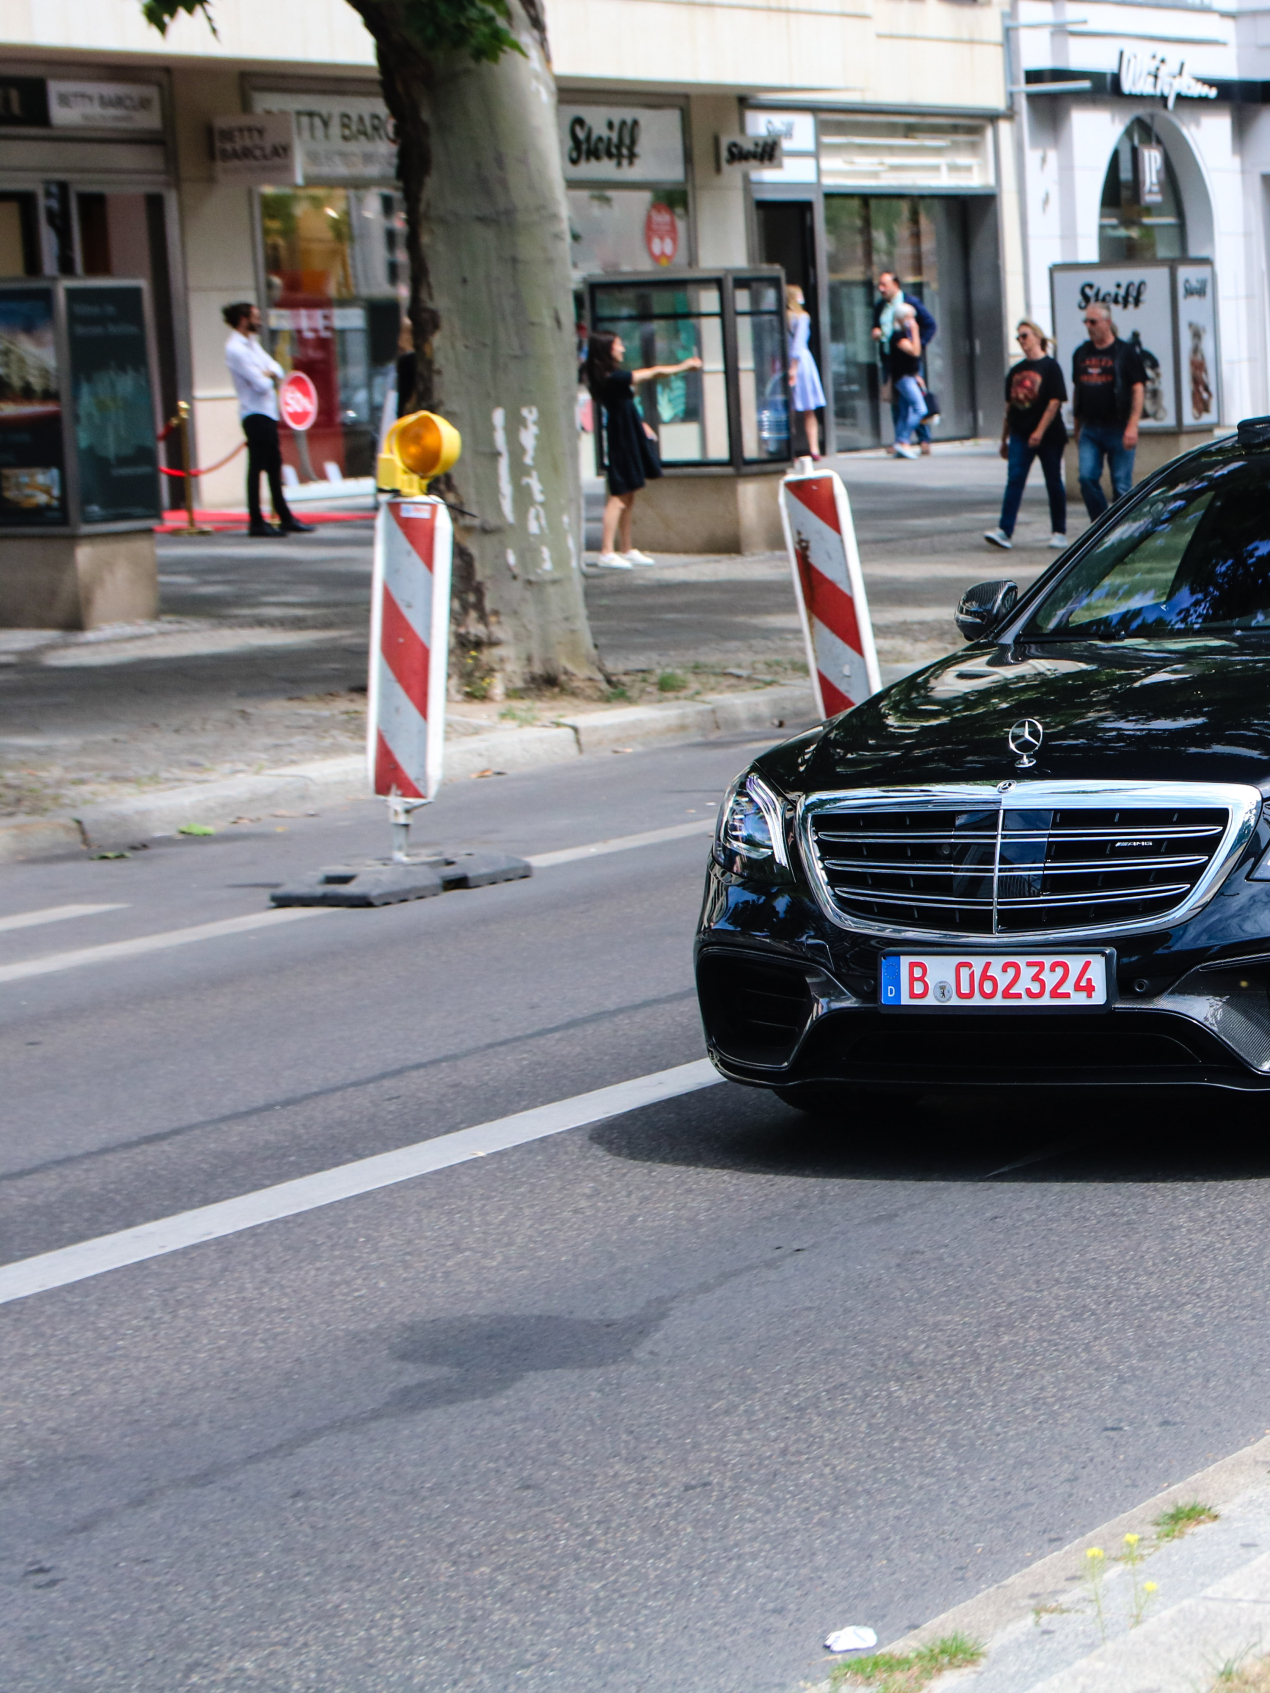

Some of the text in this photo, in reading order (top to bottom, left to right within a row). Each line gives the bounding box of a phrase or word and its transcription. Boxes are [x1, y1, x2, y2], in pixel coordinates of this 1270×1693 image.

[216, 124, 265, 144] BETTY
[340, 112, 400, 146] BARC
[567, 115, 640, 168] Steiff
[216, 144, 290, 163] BARCLAY
[725, 139, 779, 165] Steiff
[1078, 280, 1147, 310] Steiff
[1183, 277, 1208, 298] Steiff
[887, 986, 896, 998] D
[908, 960, 1096, 1000] B 062324
